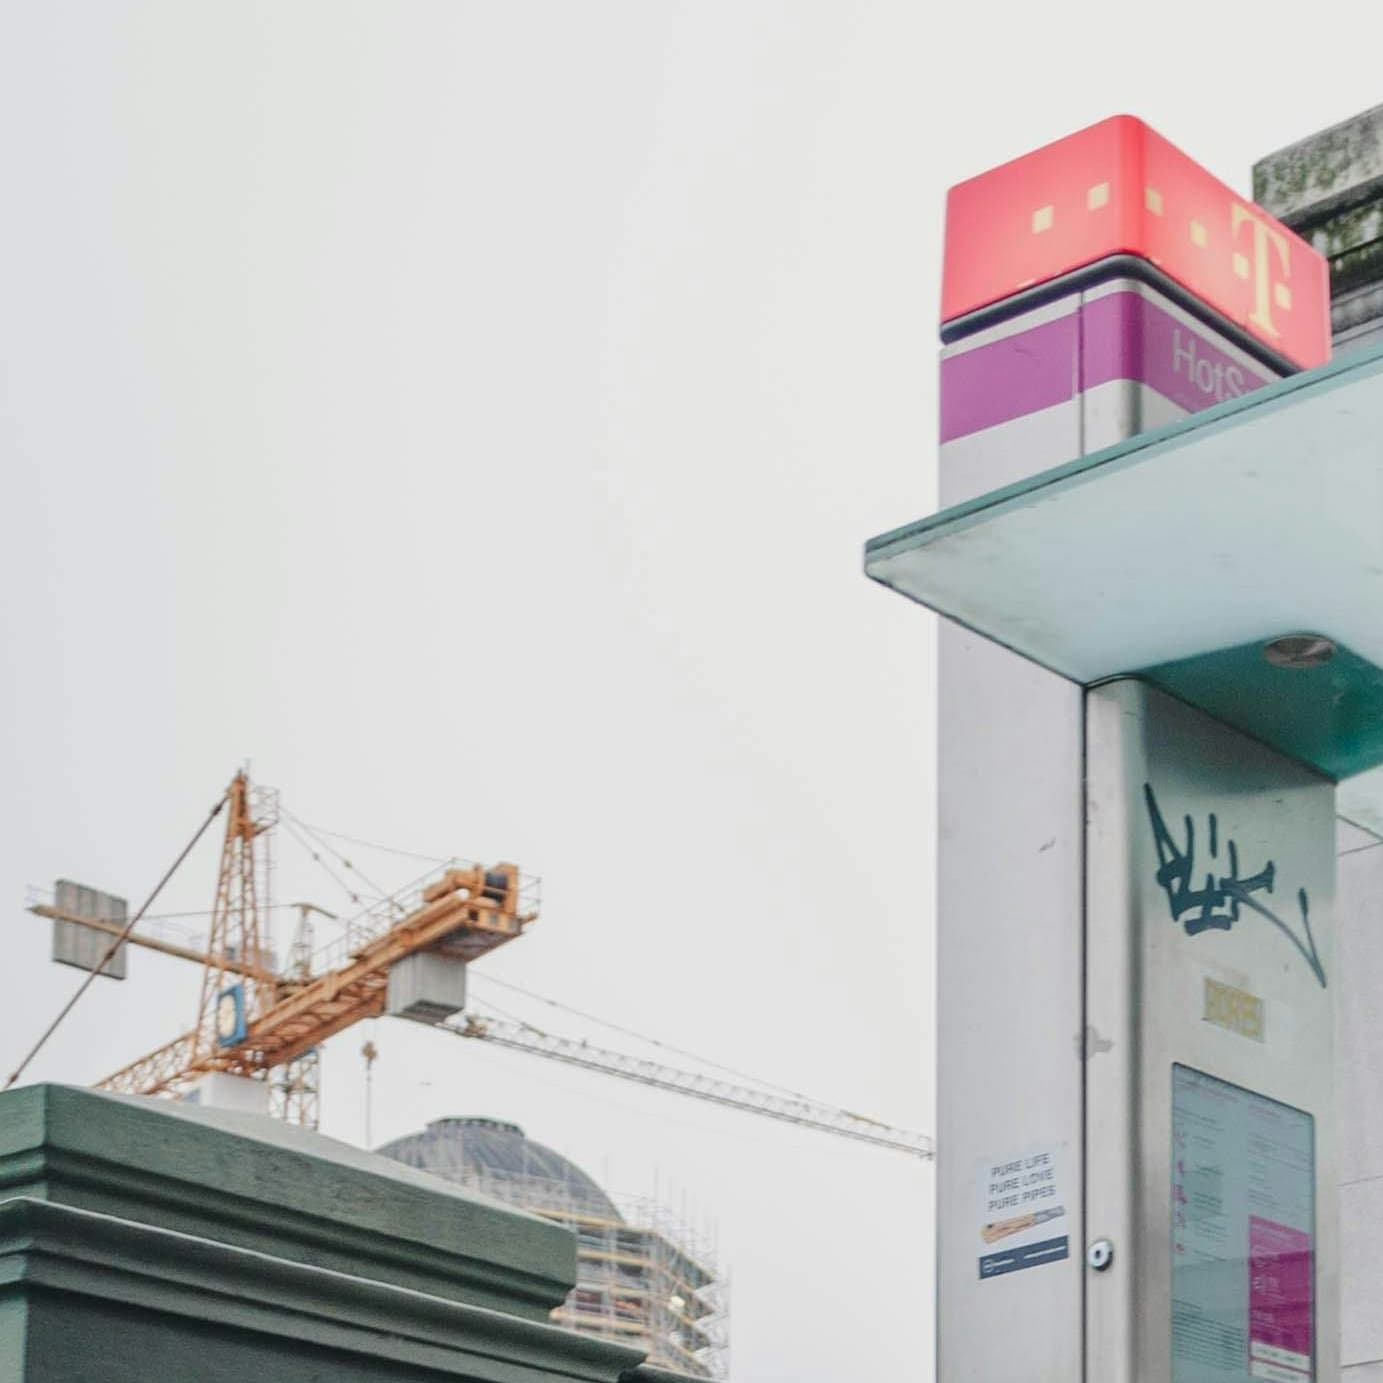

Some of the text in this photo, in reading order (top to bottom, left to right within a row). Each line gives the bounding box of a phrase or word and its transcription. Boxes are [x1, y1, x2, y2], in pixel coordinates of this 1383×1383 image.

[991, 1159, 1022, 1177] PURE
[989, 1177, 1019, 1194] PURE
[987, 1194, 1019, 1211] PURE
